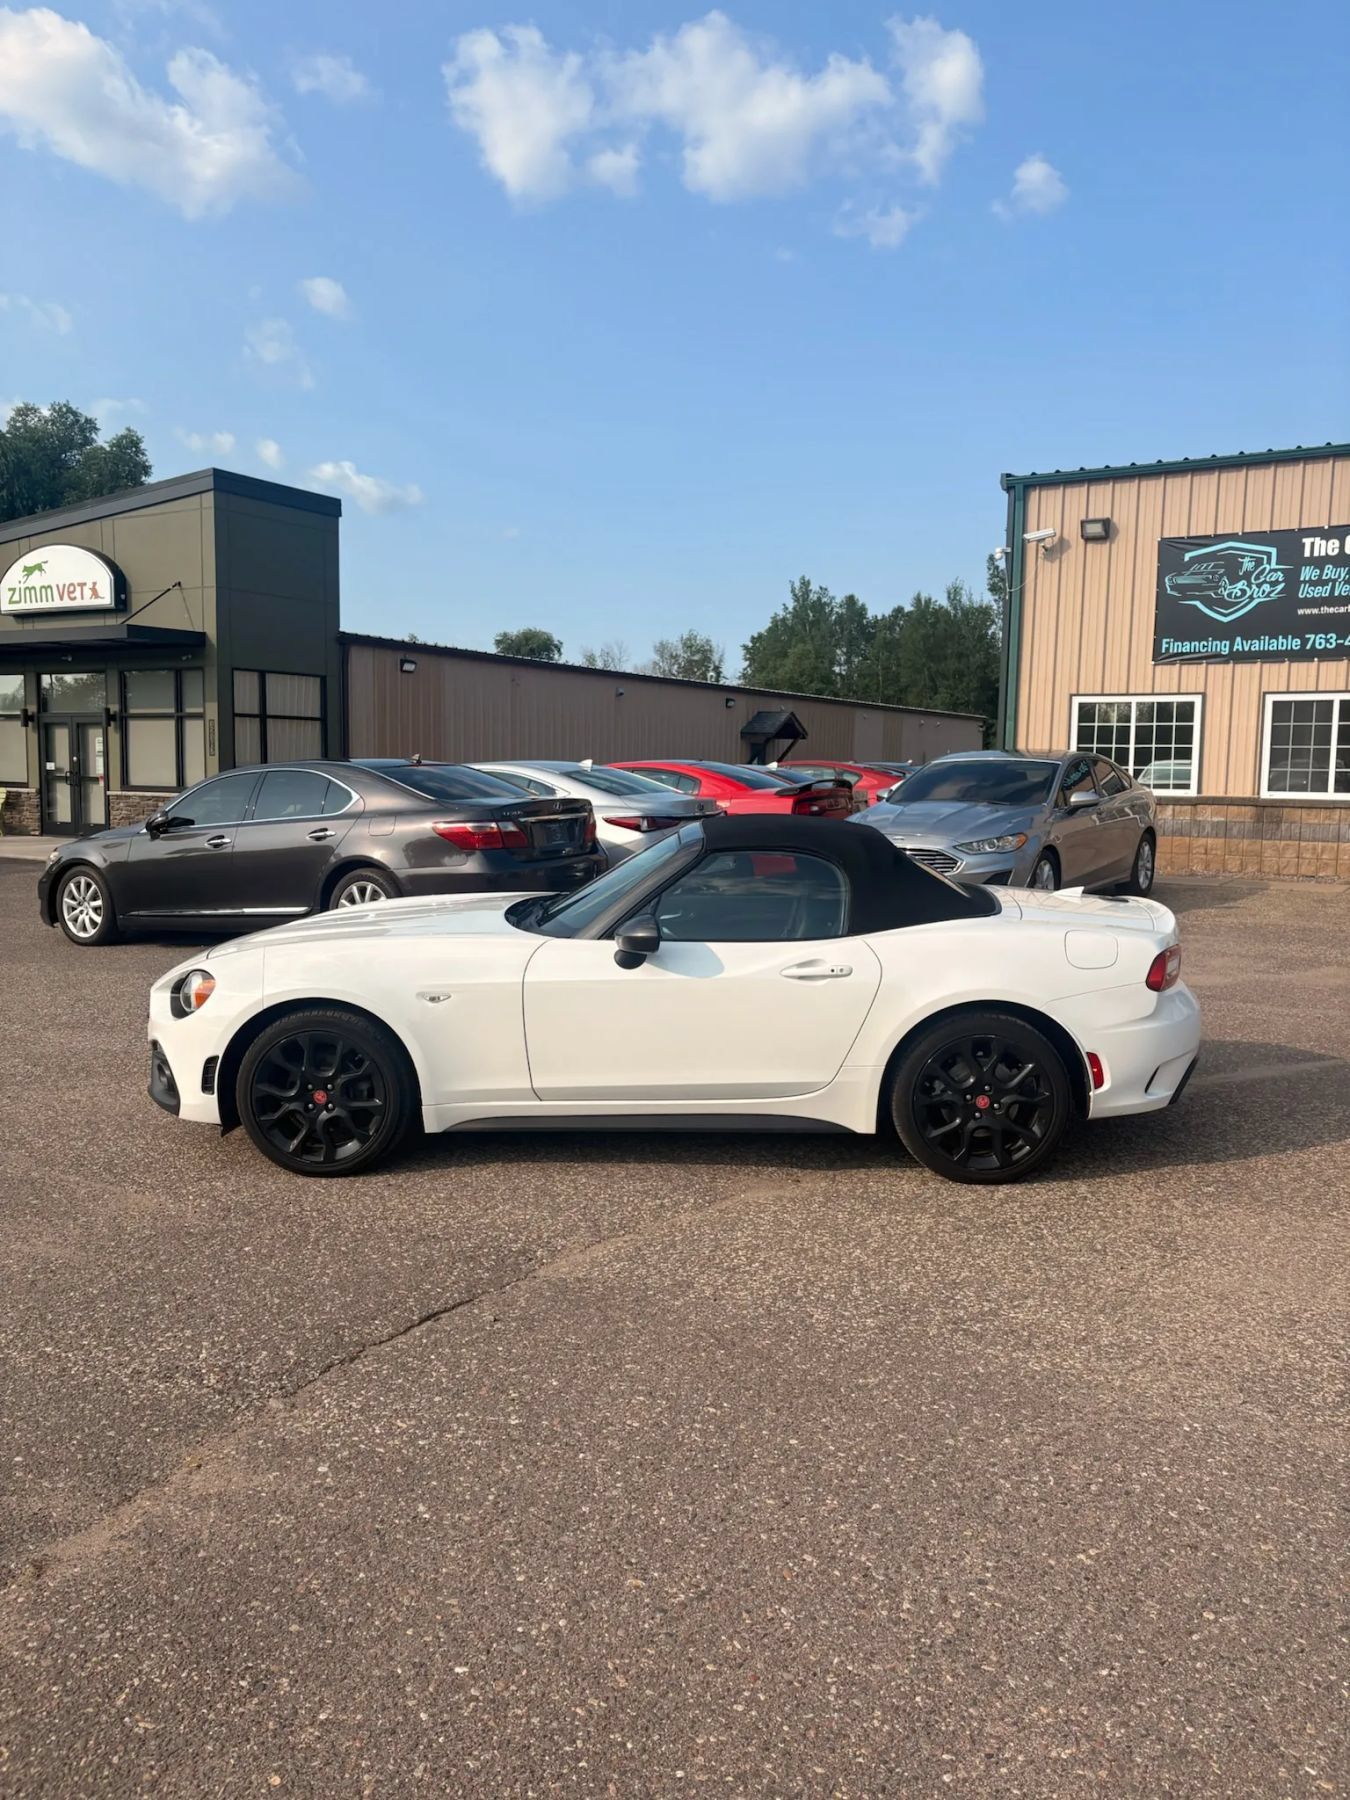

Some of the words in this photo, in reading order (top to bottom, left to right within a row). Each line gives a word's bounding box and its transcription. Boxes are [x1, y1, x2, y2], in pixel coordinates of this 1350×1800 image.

[1302, 536, 1340, 557] The
[1251, 564, 1286, 584] Car
[1300, 565, 1320, 581] We
[1322, 564, 1349, 582] Buy,
[1298, 581, 1333, 598] Used
[1334, 580, 1350, 597] Ve
[1161, 636, 1230, 655] Financing
[1233, 635, 1301, 652] Available
